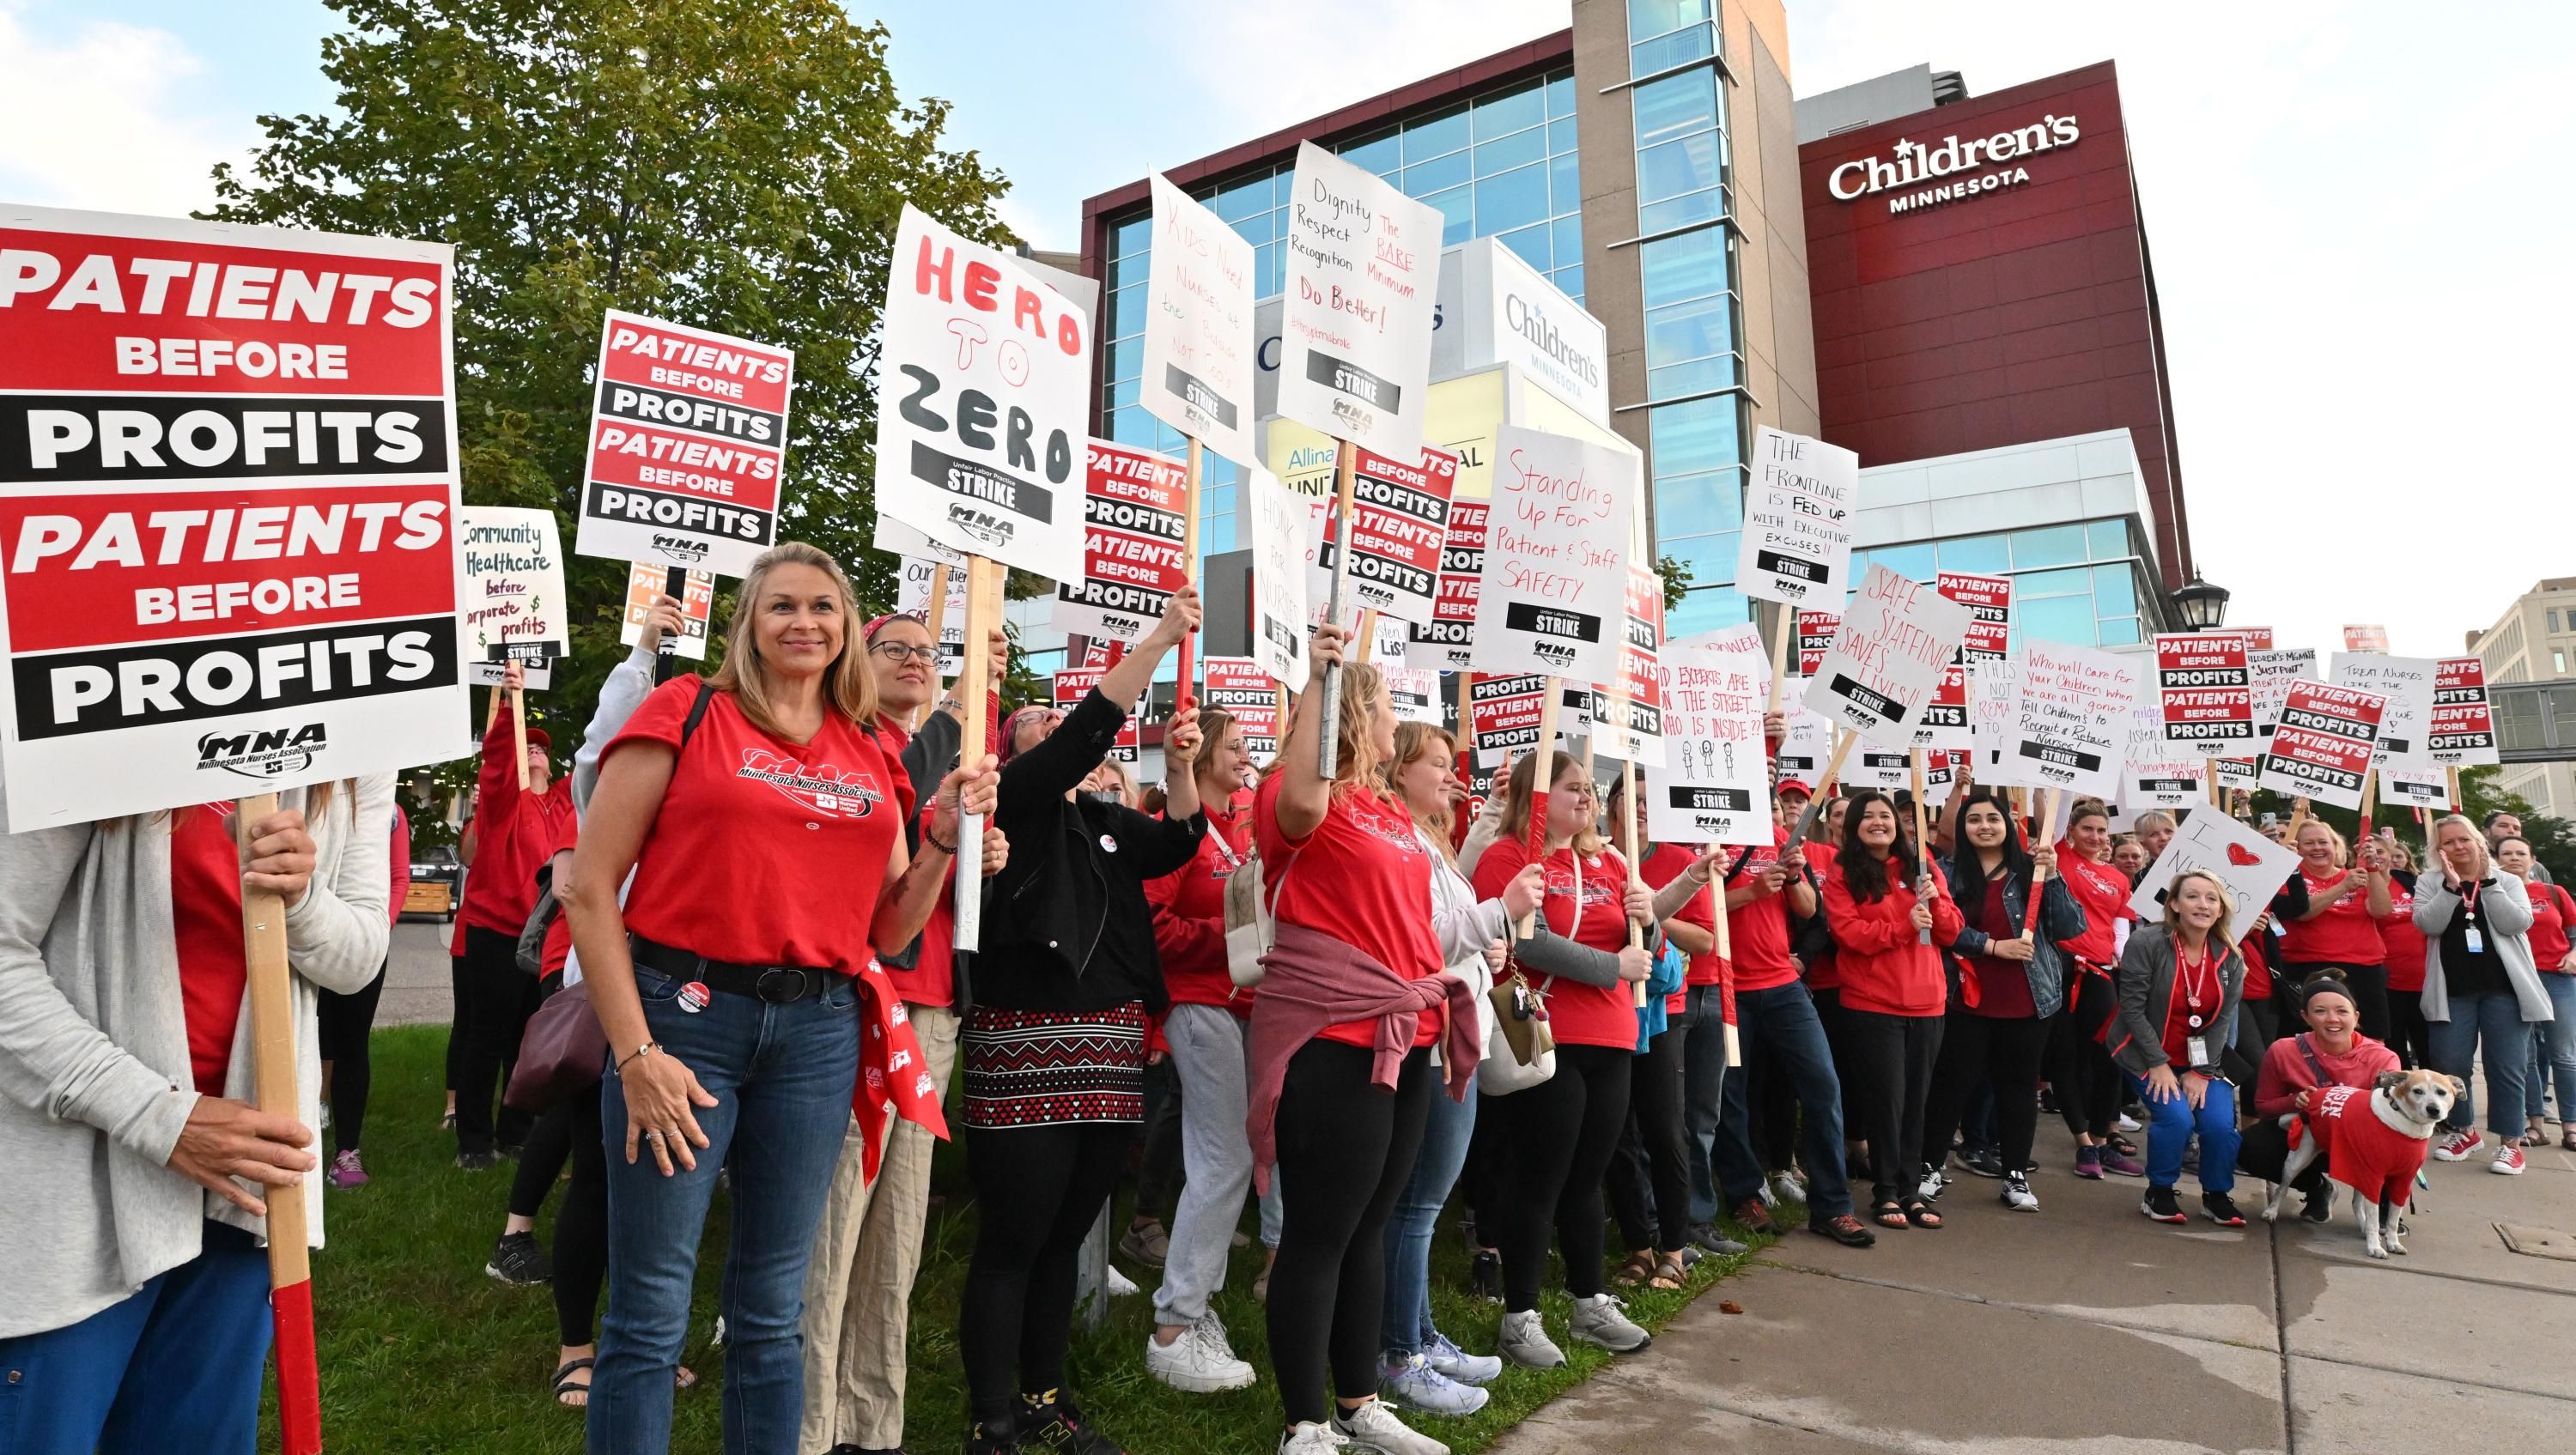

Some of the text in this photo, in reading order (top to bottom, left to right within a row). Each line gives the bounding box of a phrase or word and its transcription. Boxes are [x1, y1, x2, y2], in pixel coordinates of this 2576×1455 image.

[1829, 114, 2080, 200] Children's
[1890, 167, 2030, 214] MINNESOTA
[1315, 179, 1371, 233] Dignity
[1297, 203, 1350, 242] Respect
[1379, 214, 1400, 239] The
[1291, 234, 1353, 271] Recognition
[1376, 237, 1415, 270] BARE
[0, 248, 439, 328] PATIENTS
[915, 235, 1081, 355] HERO
[1300, 275, 1321, 306] Do
[947, 318, 1029, 387] TO
[1505, 292, 1598, 388] Children's
[116, 336, 348, 380] BEFORE
[611, 328, 787, 385] PATIENTS
[650, 366, 743, 400] BEFORE
[1335, 369, 1376, 403] STRIKE
[1531, 353, 1582, 399] MINNESOTA
[613, 388, 771, 440] PROFITS
[1187, 384, 1218, 418] STRIKE
[900, 364, 1072, 483] ZERO
[27, 409, 423, 470] PROFITS
[598, 427, 776, 480] PATIENTS
[1768, 434, 1807, 462] THE
[639, 465, 733, 497] BEFORE
[953, 461, 1016, 486] Unfair Labor Practice
[1366, 459, 1427, 487] BEFORE
[1504, 449, 1613, 518] Standing
[1765, 464, 1847, 501] FRONTLINE
[947, 469, 1016, 508] STRIKE
[1106, 480, 1169, 504] BEFORE
[601, 490, 760, 538] PROFITS
[950, 506, 1013, 535] MNA
[1517, 497, 1589, 530] Up For
[1769, 493, 1846, 521] IS FED UP
[11, 500, 447, 573] PATIENTS
[1753, 512, 1851, 543] WITH EXECUTIVE
[653, 536, 708, 552] MNA
[1353, 533, 1415, 560] BEFORE
[1497, 526, 1558, 559] Patient
[1580, 540, 1619, 570] Staff
[466, 551, 550, 577] Healthcare
[908, 564, 934, 583] Our
[1096, 561, 1159, 584] BEFORE
[1777, 560, 1810, 579] STRIKE
[486, 579, 526, 596] before
[1498, 561, 1584, 603] SAFETY
[1868, 567, 1922, 615] SAFE
[1939, 576, 2008, 593] PATIENTS
[136, 573, 361, 626] BEFORE
[1955, 592, 1991, 603] BEFORE
[501, 616, 546, 643] profits
[1535, 615, 1580, 638] STRIKE
[1873, 608, 1953, 673] STAFFING
[507, 647, 542, 658] STRIKE
[1535, 641, 1576, 658] MNA
[1837, 627, 1889, 673] SAVES
[2160, 640, 2242, 654] PATIENTS
[2180, 656, 2226, 666] BEFORE
[50, 631, 434, 725] PROFITS
[1679, 666, 1749, 691] EXPERTS ARE
[1983, 663, 2016, 679] THIS
[2029, 649, 2134, 683] Who will care for
[2166, 671, 2242, 685] PROFITS
[2342, 664, 2377, 678] TREAT
[1225, 678, 1266, 687] BEFORE
[1475, 676, 1546, 698] PROFITS
[1990, 682, 2013, 697] NOT
[2056, 674, 2132, 702] Children when
[2291, 682, 2385, 709] PATIENTS
[2380, 682, 2403, 690] THE
[1678, 690, 1706, 712] THE
[1850, 687, 1886, 713] STRIKE
[2020, 699, 2106, 724] Tell Children's to
[2039, 691, 2057, 700] are
[2061, 694, 2079, 704] all
[2165, 692, 2248, 706] PATIENTS
[2307, 700, 2357, 717] BEFORE
[1496, 713, 1540, 728] BEFORE
[1595, 696, 1657, 732] PROFITS
[2184, 709, 2230, 718] BEFORE
[2287, 712, 2370, 738] PROFITS
[200, 723, 326, 760] MNA
[1692, 717, 1704, 735] IS
[1712, 718, 1747, 741] INSIDE
[2020, 714, 2112, 746] Recruit Retain
[2171, 724, 2248, 738] PROFITS
[197, 755, 246, 770] Minnesota
[246, 749, 276, 763] Nurses
[278, 743, 326, 758] Association
[2040, 749, 2078, 766] STRIKE
[2275, 731, 2372, 759] PATIENTS
[2293, 747, 2342, 766] BEFORE
[1878, 758, 1902, 767] STRIKE
[2272, 758, 2356, 789] PROFITS
[736, 767, 884, 803] Minnesota Nurses Association
[2408, 785, 2432, 795] STRIKE
[1693, 793, 1731, 809] STRIKE
[1696, 814, 1731, 826] MNA
